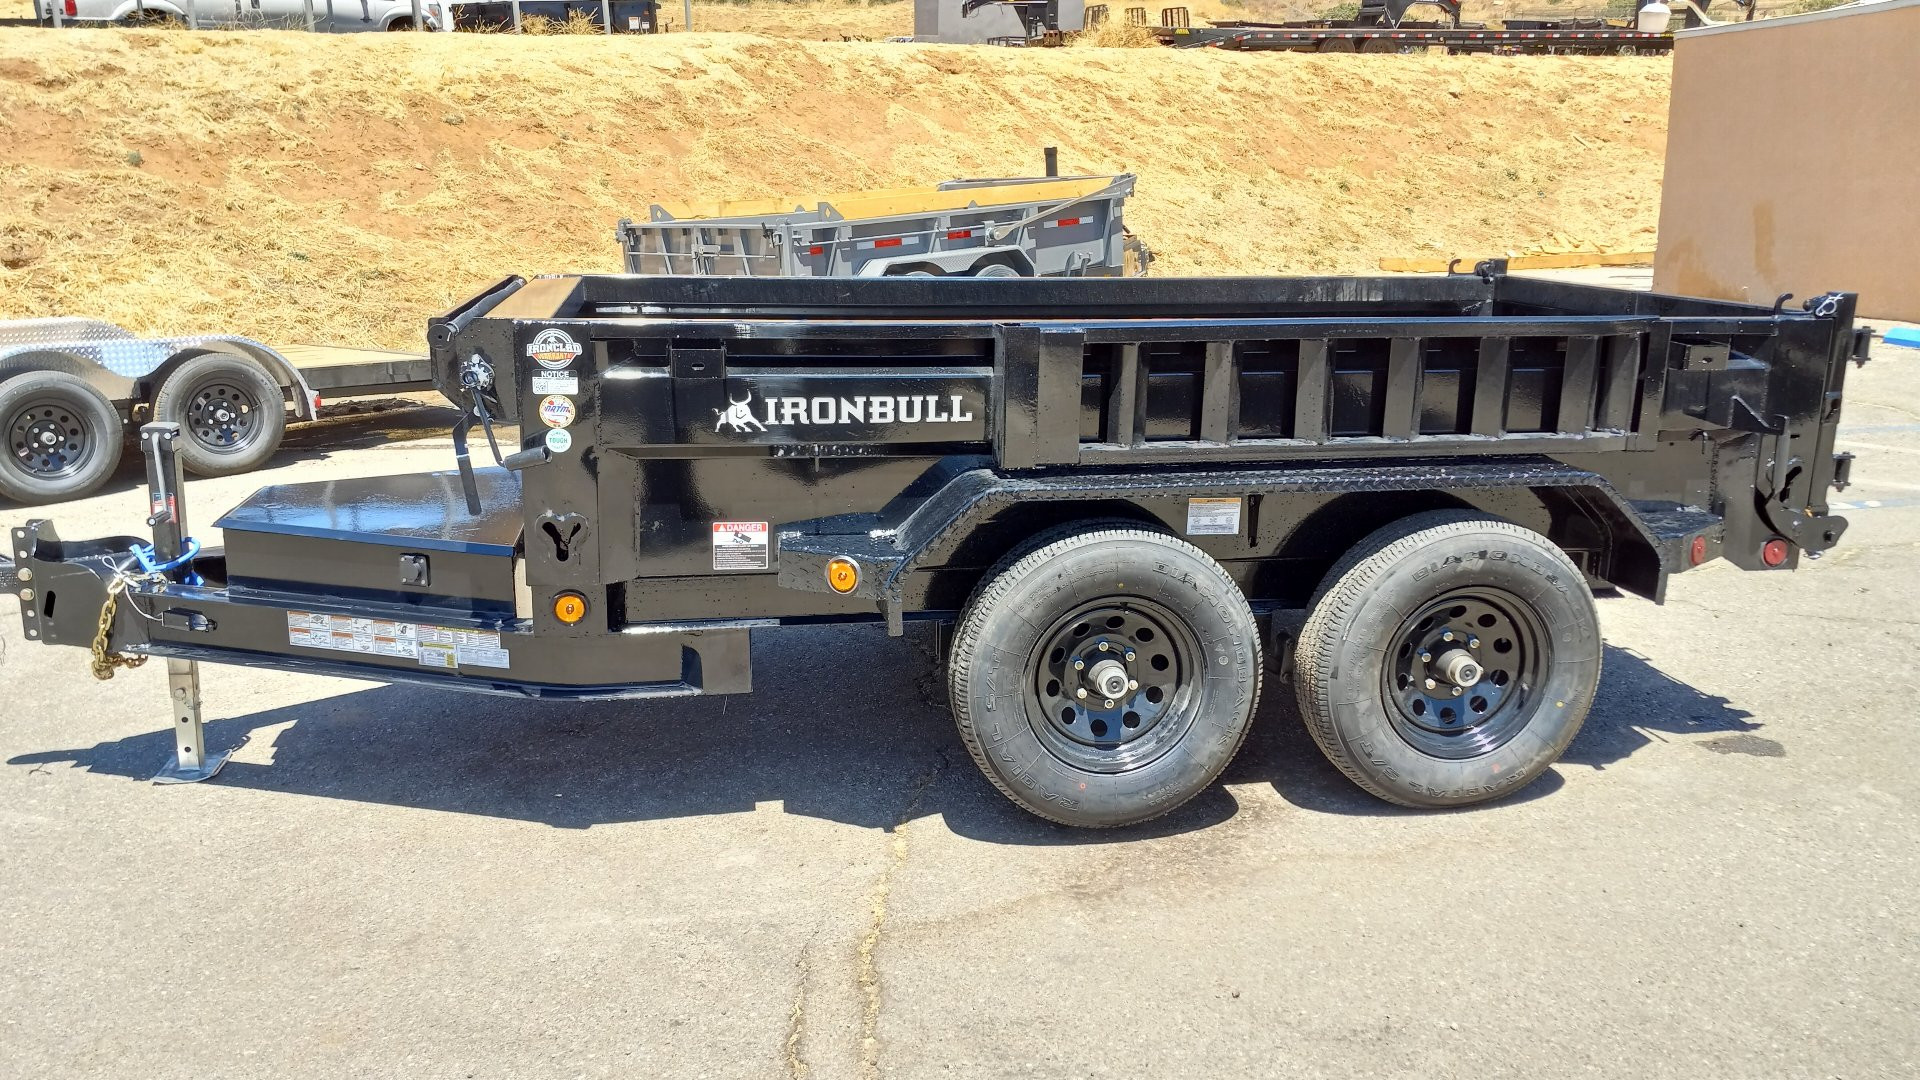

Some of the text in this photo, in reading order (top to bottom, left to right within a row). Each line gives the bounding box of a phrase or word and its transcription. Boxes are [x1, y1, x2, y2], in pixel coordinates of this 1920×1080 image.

[528, 343, 580, 354] IRONCLAD
[541, 370, 570, 378] NOTICE
[764, 395, 973, 425] IRONBULL
[726, 523, 762, 532] DANGER
[992, 722, 1080, 811] RADIAL
